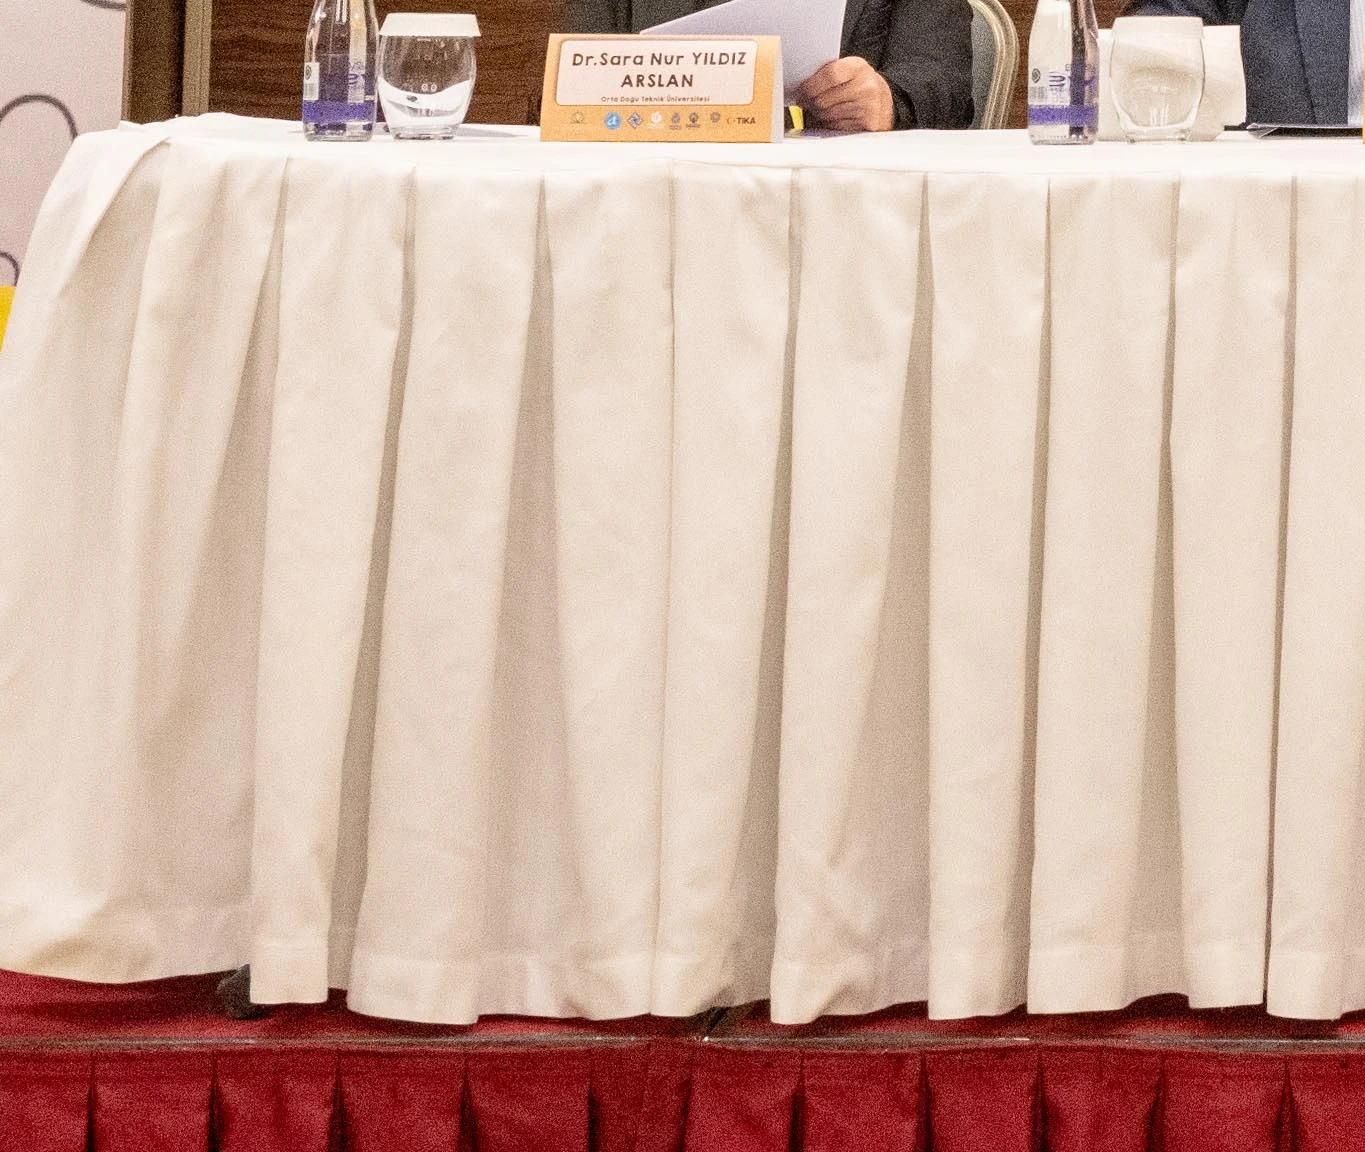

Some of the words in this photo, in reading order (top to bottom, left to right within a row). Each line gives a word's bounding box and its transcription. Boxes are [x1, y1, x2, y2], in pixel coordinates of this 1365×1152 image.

[650, 53, 684, 66] Nur
[692, 52, 747, 66] YILDIZ
[621, 74, 694, 88] ARSLAN
